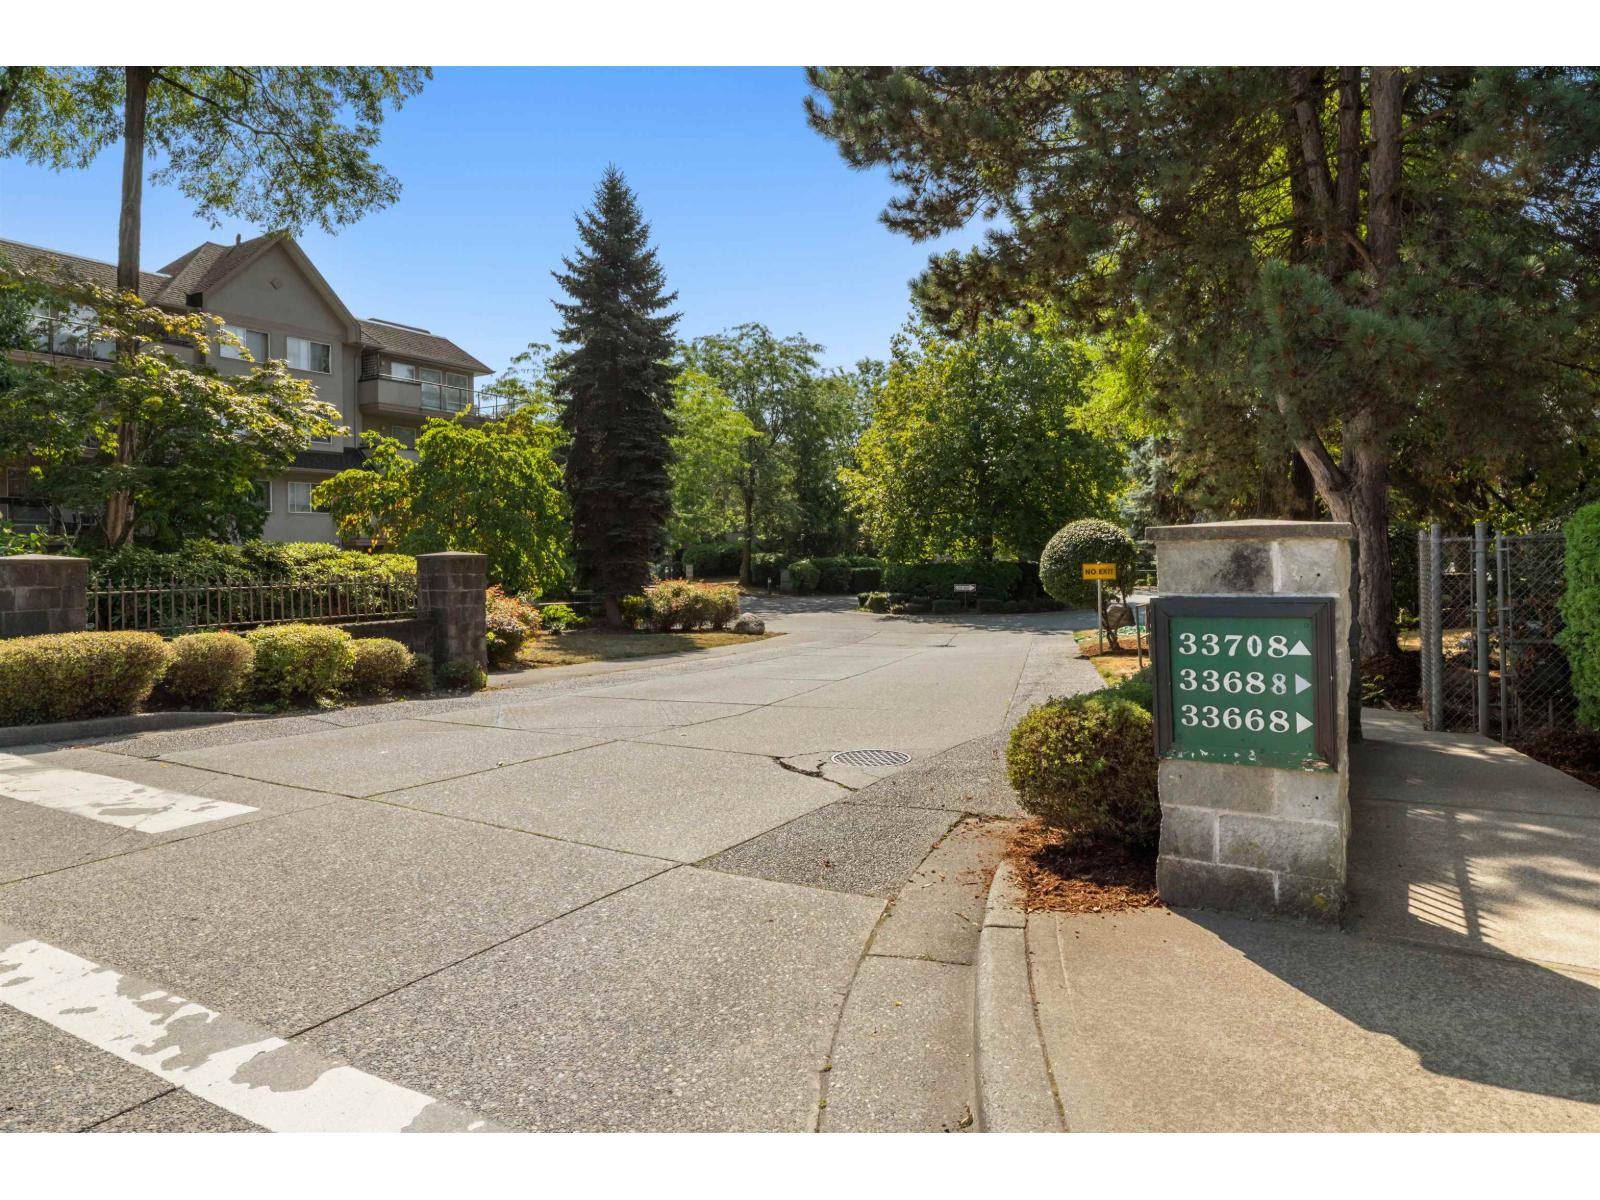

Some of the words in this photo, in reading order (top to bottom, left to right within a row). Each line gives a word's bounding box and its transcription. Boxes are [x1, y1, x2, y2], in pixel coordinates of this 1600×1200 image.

[1178, 632, 1289, 658] 33708
[1179, 668, 1287, 695] 33688
[1181, 704, 1290, 733] 33668
